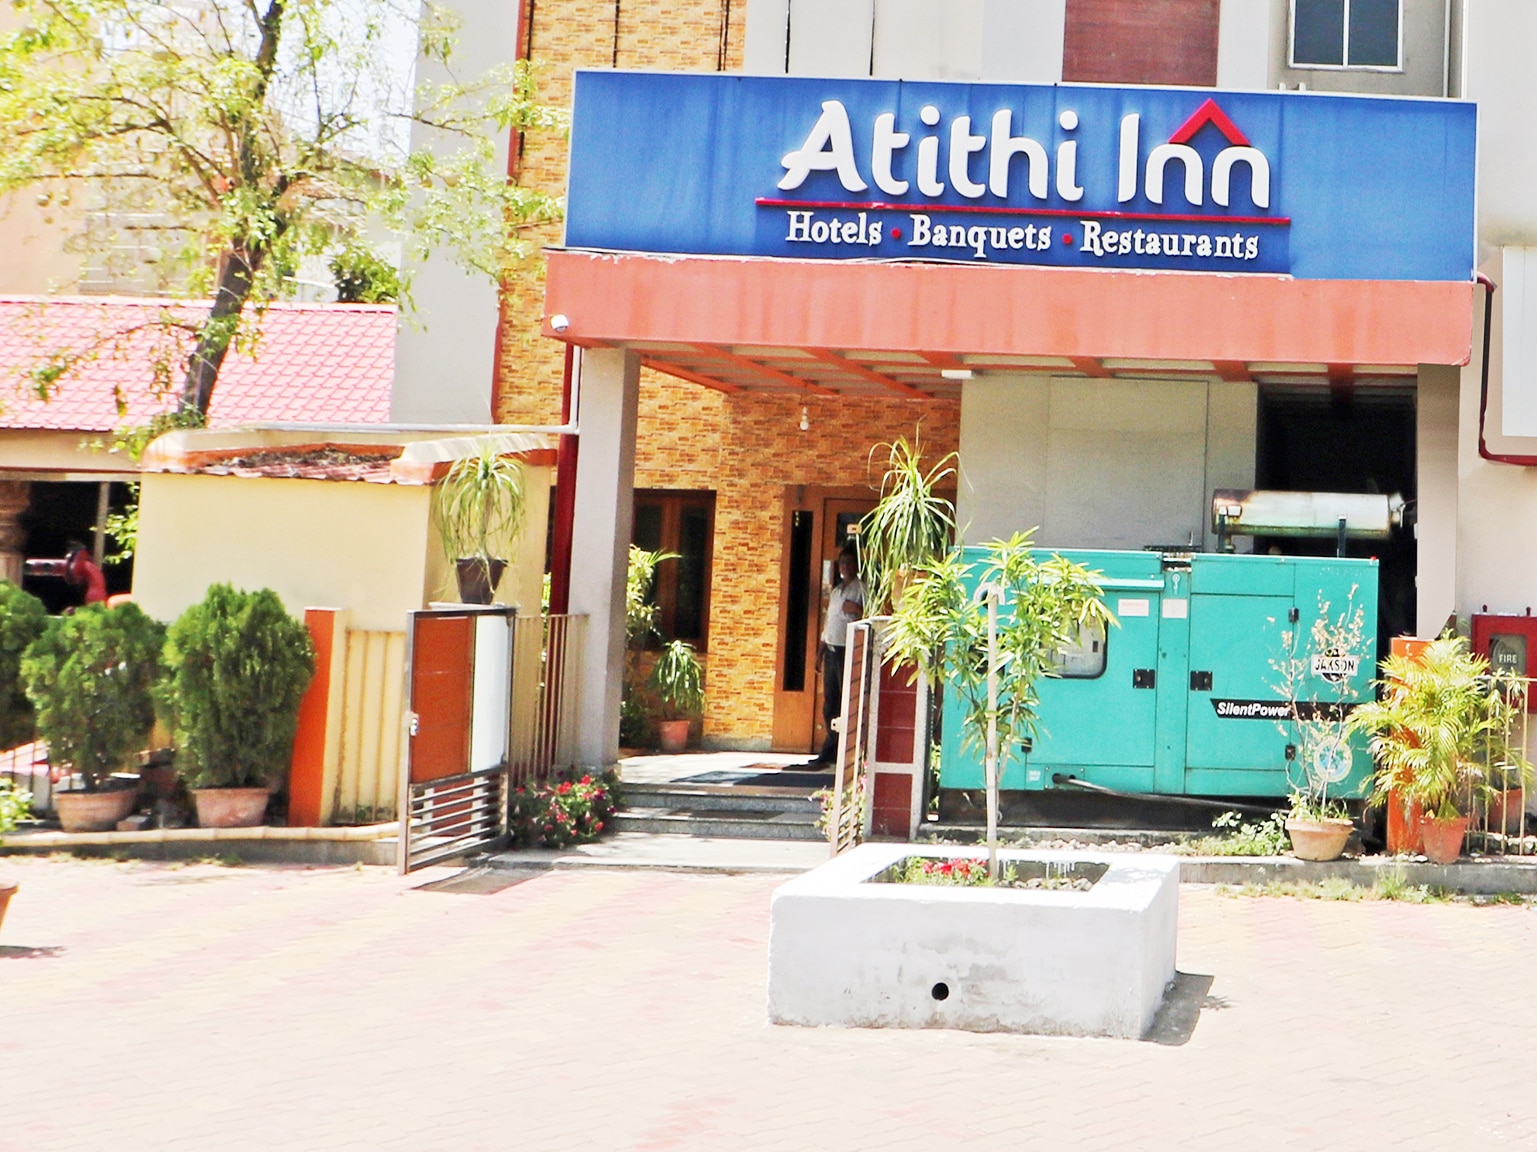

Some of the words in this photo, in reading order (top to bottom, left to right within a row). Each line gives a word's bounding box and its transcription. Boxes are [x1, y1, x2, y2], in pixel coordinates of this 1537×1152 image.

[777, 99, 1085, 202] Atithi
[1117, 112, 1270, 209] Inn
[785, 210, 884, 247] Hotels
[908, 213, 1053, 258] Banquets
[1079, 220, 1260, 261] Restaurants
[1498, 654, 1518, 664] FIRE
